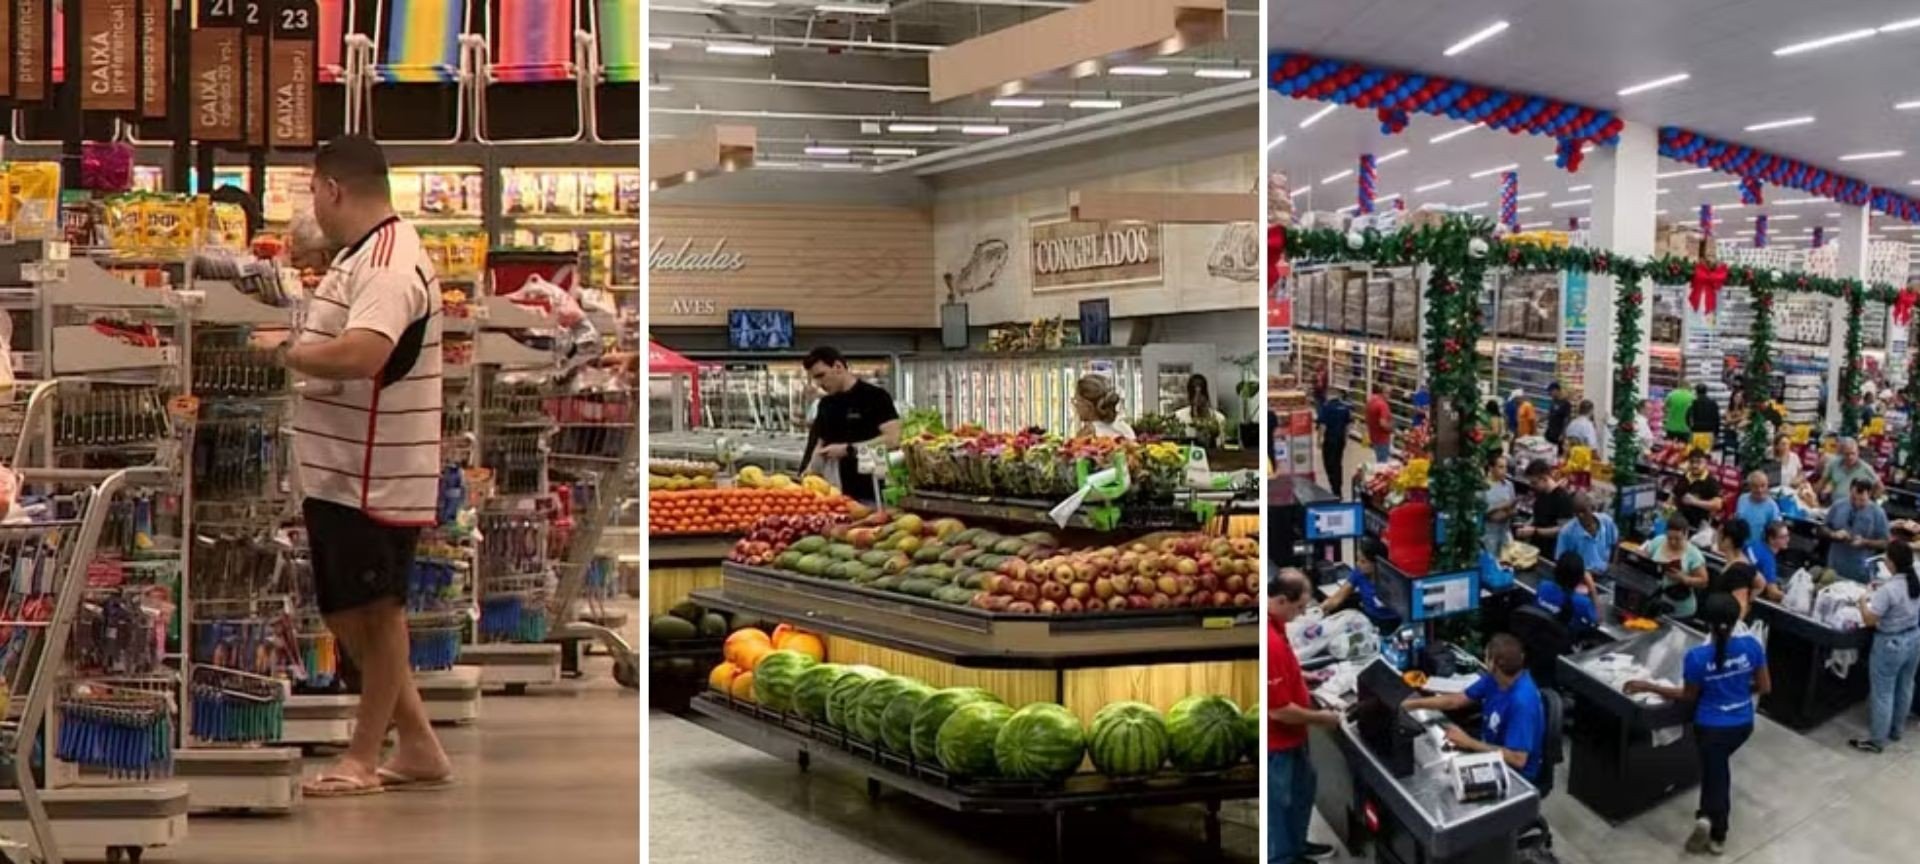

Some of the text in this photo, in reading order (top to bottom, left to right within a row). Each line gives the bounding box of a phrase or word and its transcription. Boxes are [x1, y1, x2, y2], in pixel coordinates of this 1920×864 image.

[210, 0, 234, 16] 21
[281, 9, 309, 30] 23
[90, 31, 110, 95] CAIXA
[111, 4, 127, 93] preferencial
[218, 64, 231, 81] 20
[201, 69, 218, 127] CAIXA
[276, 84, 293, 138] CAIXA
[1036, 226, 1149, 274] CONGELADOS
[670, 299, 716, 315] AVES
